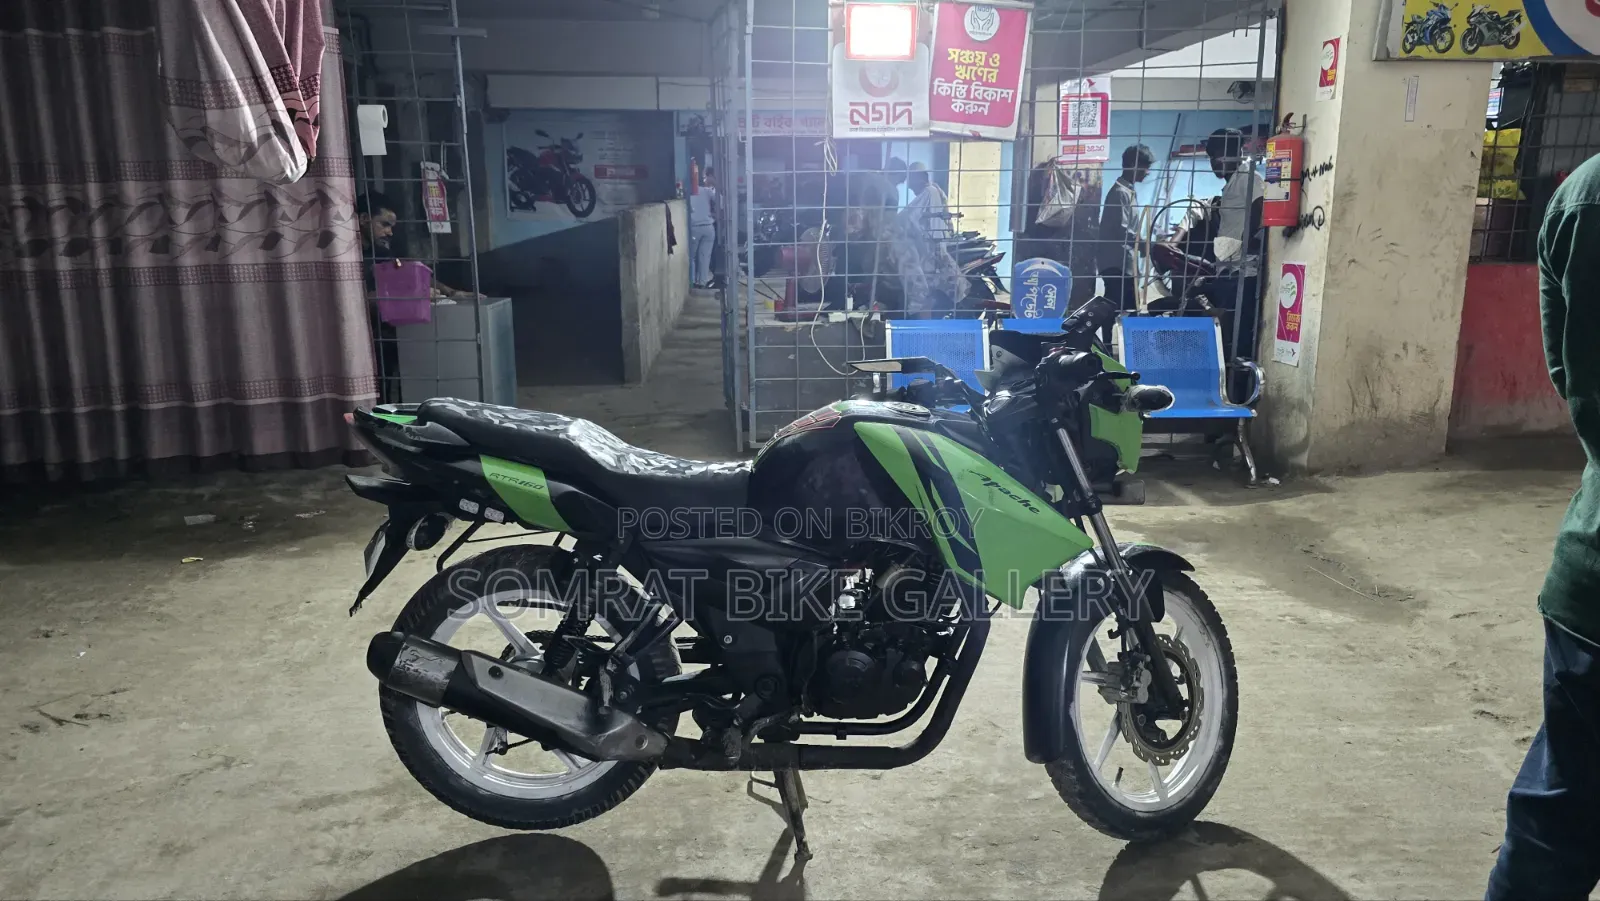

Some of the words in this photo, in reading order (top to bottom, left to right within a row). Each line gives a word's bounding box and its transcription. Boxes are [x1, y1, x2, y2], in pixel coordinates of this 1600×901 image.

[947, 48, 987, 66] সঞ্চয়
[989, 53, 1000, 67] ও
[955, 64, 999, 83] ঋণের
[933, 77, 968, 98] কিস্তি
[970, 81, 1014, 103] বিকাশ
[849, 102, 912, 125] নগদ
[951, 98, 990, 115] করুন
[967, 469, 1040, 514] Apache
